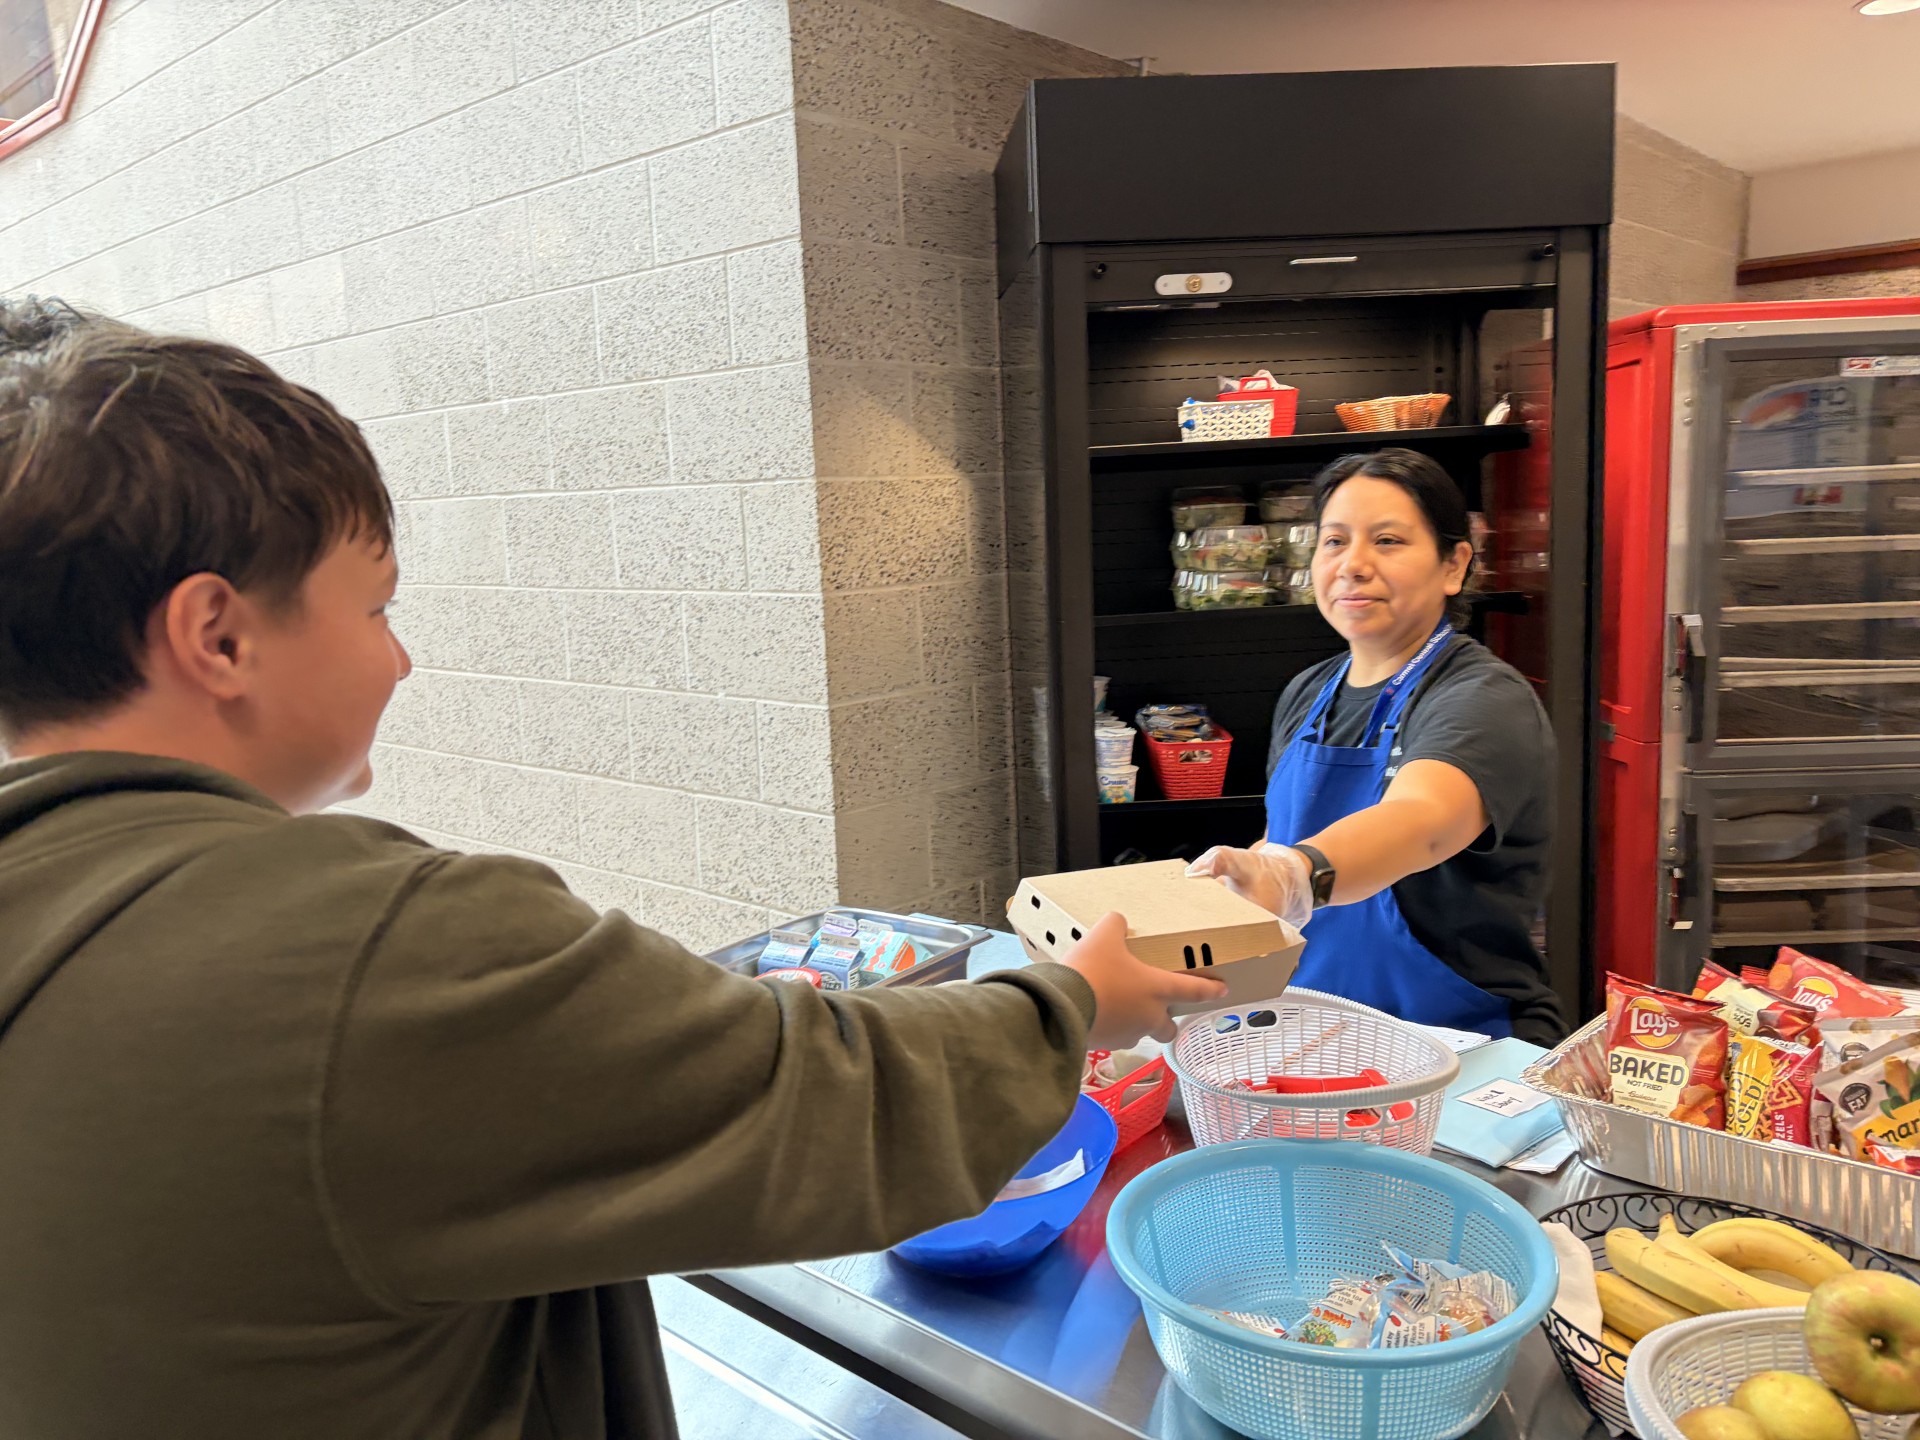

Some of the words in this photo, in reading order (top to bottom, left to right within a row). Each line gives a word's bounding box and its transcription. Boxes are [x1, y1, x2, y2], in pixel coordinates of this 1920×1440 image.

[1392, 662, 1415, 686] Carmel
[1610, 1053, 1686, 1086] BAKED
[1627, 1079, 1642, 1087] NOT
[1642, 1082, 1663, 1091] FRIED
[1733, 1085, 1763, 1137] GOLD
[1848, 1095, 1868, 1112] FAT
